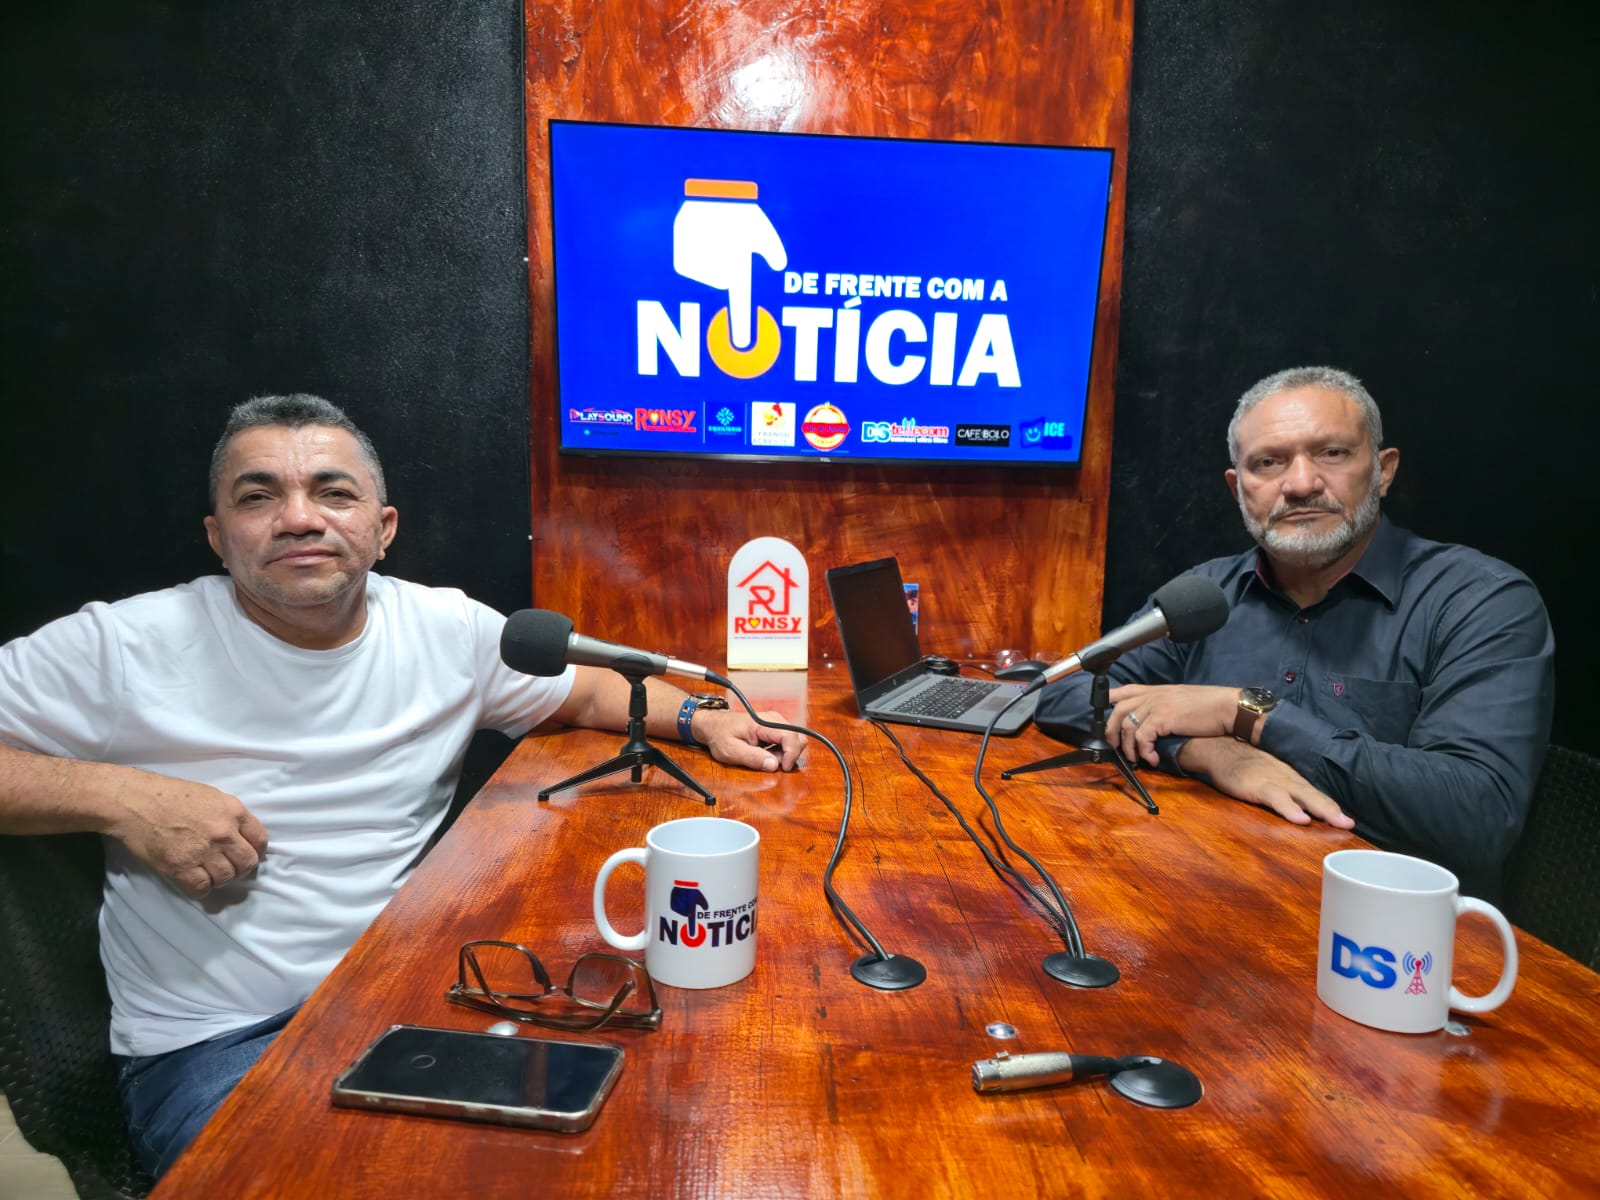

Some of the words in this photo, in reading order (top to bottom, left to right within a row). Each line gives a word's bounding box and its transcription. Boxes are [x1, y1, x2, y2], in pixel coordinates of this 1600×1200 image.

[784, 271, 819, 294] DE
[825, 273, 921, 298] FRENTE
[926, 277, 984, 301] COM
[990, 280, 1008, 301] A
[637, 297, 1022, 388] NOTÍCIA
[1043, 421, 1065, 437] ICE
[659, 909, 758, 948] NOTÍCI
[697, 911, 711, 919] DE
[713, 904, 747, 919] FRENTE
[1331, 931, 1397, 989] DS
